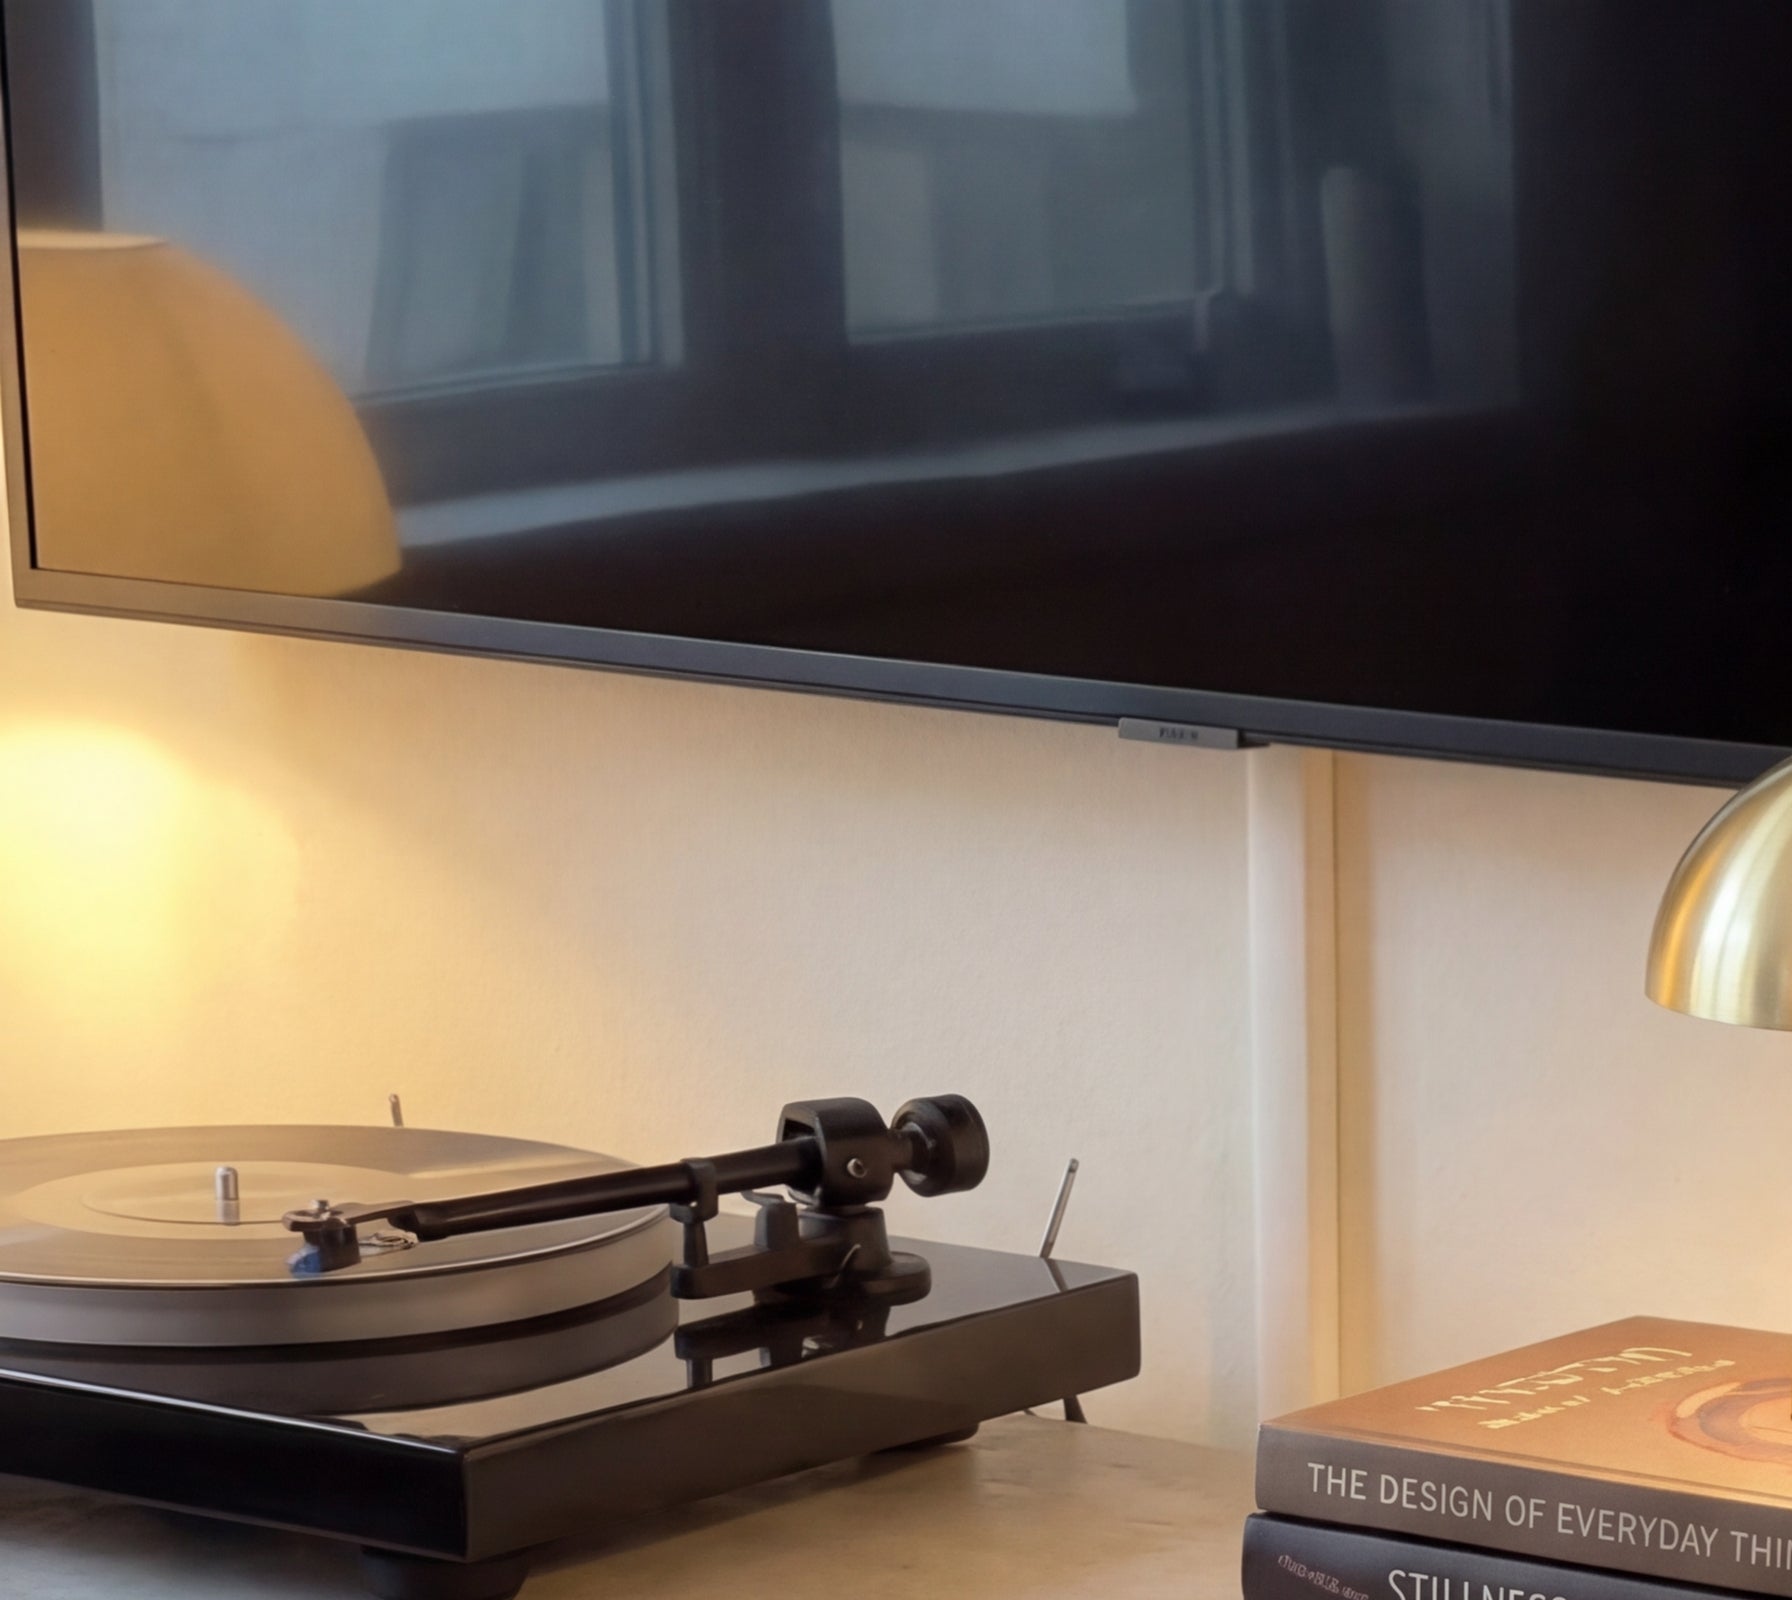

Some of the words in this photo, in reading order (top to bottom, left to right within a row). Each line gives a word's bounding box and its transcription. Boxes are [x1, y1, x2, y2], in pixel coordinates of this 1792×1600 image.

[1308, 1462, 1368, 1501] THE
[1379, 1473, 1493, 1522] DESIGN
[1504, 1494, 1546, 1530] OF
[1556, 1503, 1718, 1557] EVERYDAY
